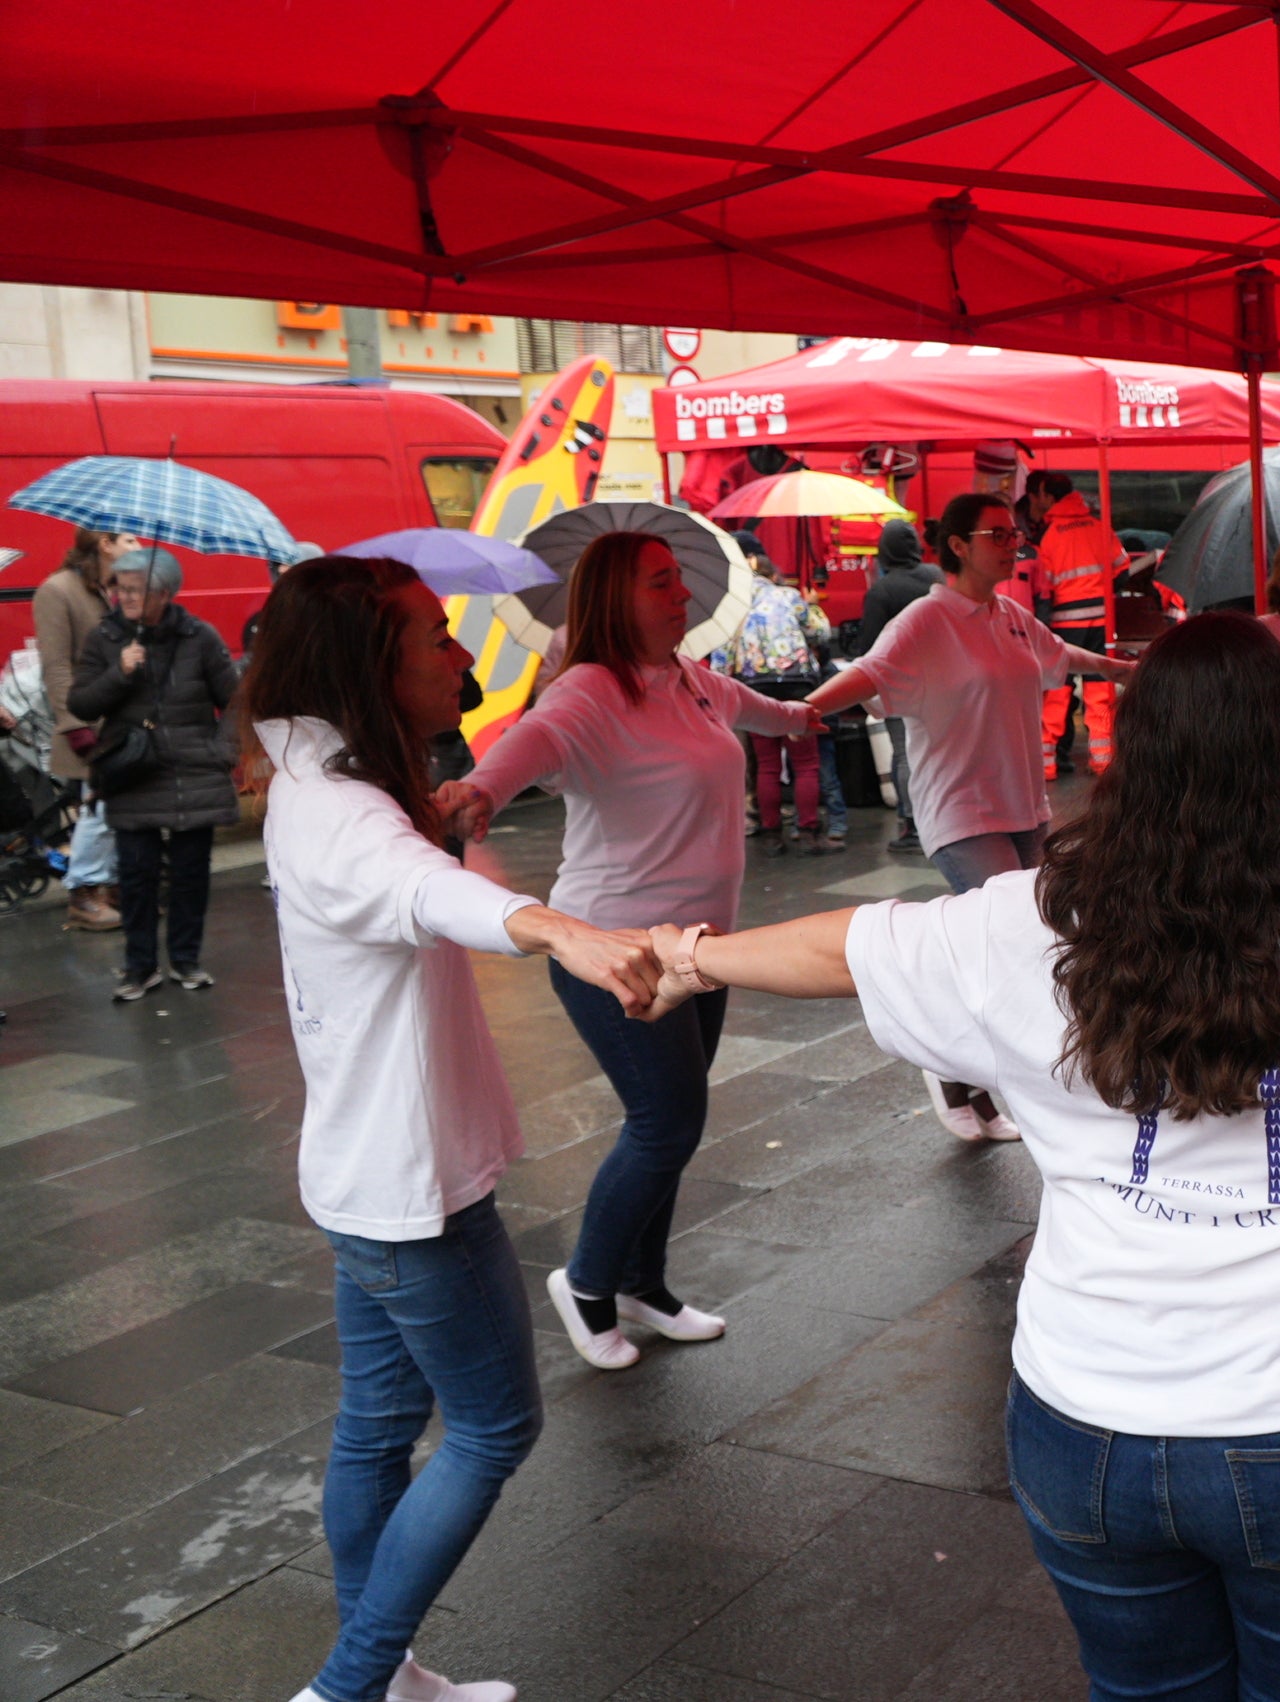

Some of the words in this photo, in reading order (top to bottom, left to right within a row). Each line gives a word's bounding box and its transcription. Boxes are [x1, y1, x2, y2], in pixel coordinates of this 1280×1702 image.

[1116, 377, 1179, 404] bombers
[675, 391, 785, 418] bombers
[1161, 1176, 1245, 1199] TERRASSA
